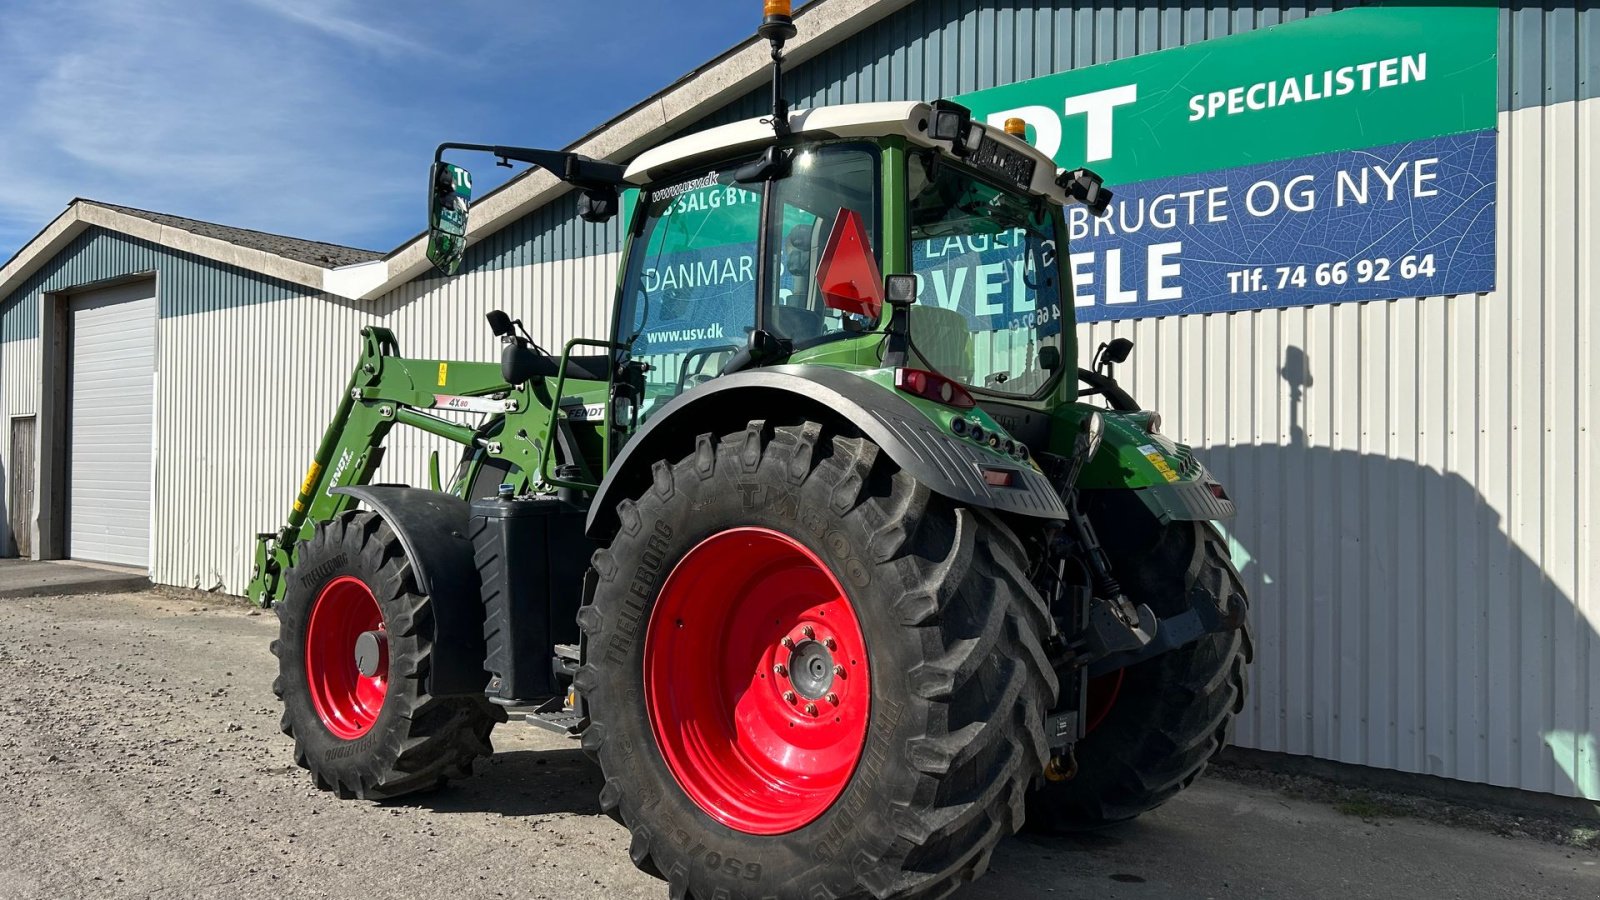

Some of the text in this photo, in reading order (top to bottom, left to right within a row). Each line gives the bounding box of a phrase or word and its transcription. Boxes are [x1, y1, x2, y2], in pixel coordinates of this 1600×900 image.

[1188, 52, 1428, 122] SPECIALISTEN
[651, 170, 719, 203] www.usv.dk
[1069, 185, 1230, 239] BRUGTE
[1245, 173, 1317, 217] OG
[1337, 158, 1440, 207] NYE
[1228, 253, 1437, 294] Tlf. 74 66 92 64
[646, 322, 724, 344] www.usv.dk
[568, 407, 604, 418] FENDT
[602, 518, 674, 669] TRELLEBORG
